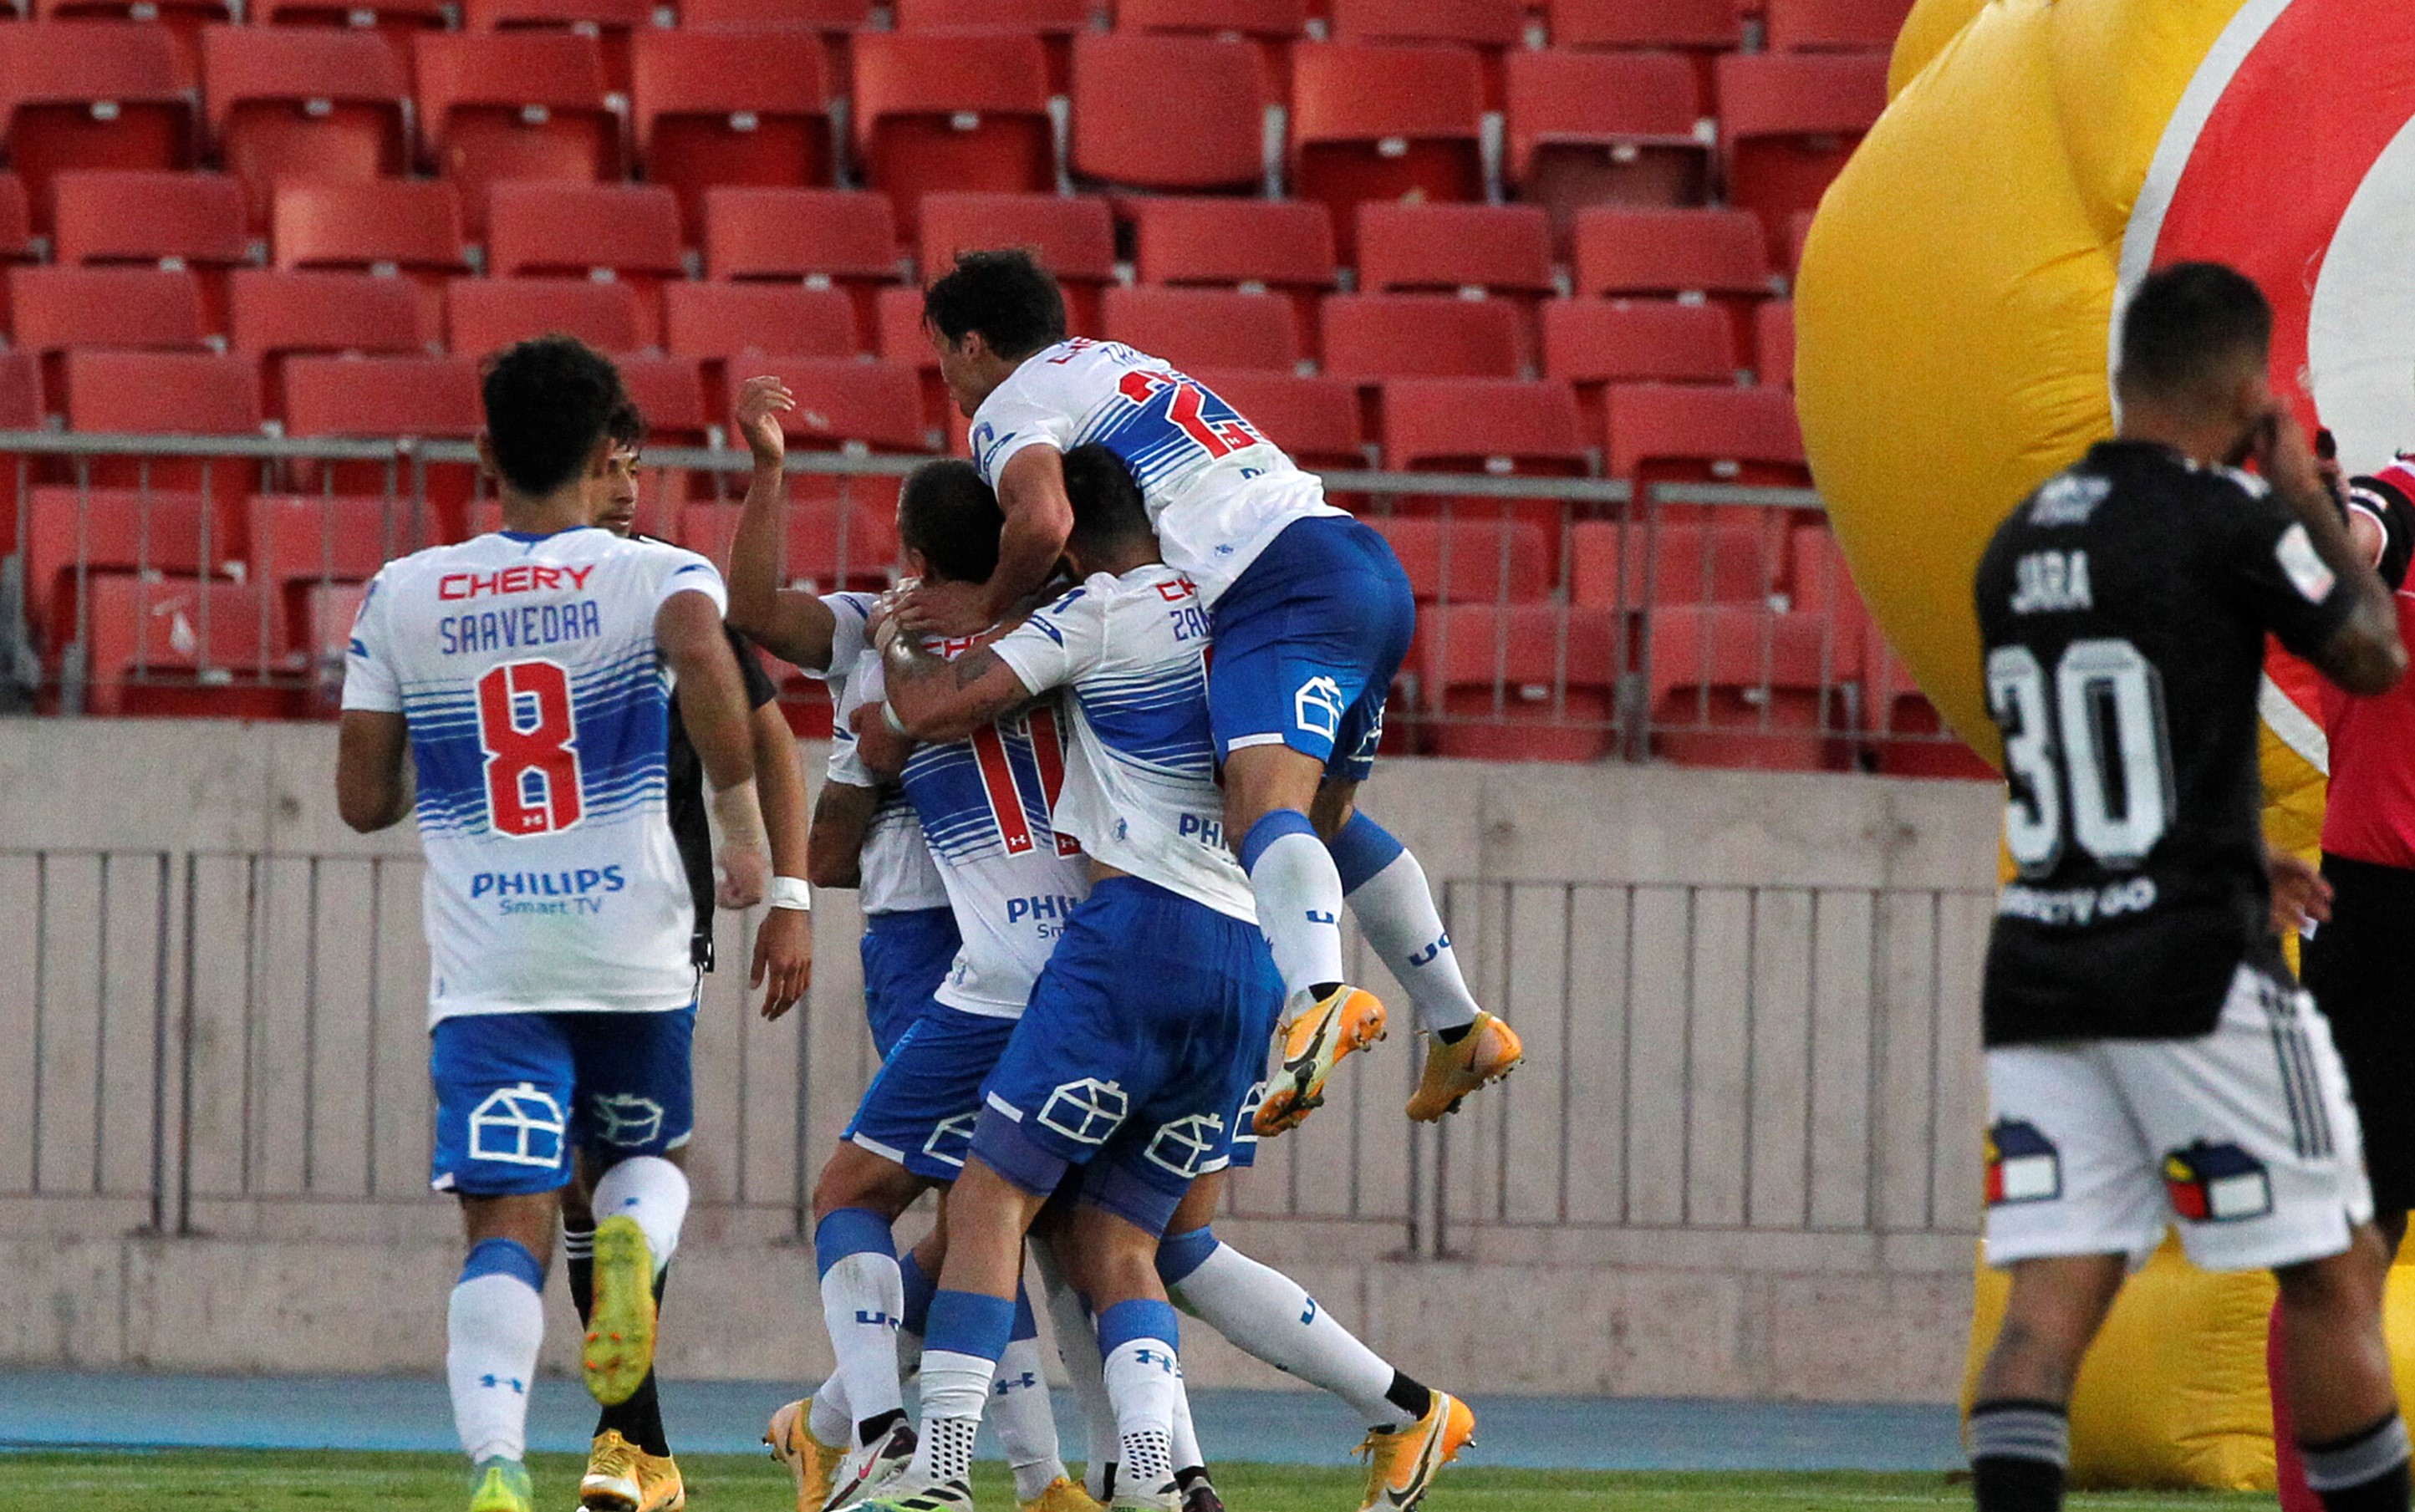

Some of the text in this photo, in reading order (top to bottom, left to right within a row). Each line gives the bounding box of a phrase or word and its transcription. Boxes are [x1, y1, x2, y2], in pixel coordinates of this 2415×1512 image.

[438, 564, 595, 602] CHERY
[2010, 548, 2093, 614] JARA
[441, 599, 601, 655] SAAVEDRA
[475, 657, 582, 838] 8
[1985, 637, 2176, 873] 30
[471, 864, 625, 899] PHILIPS
[500, 897, 603, 916] Smart TV
